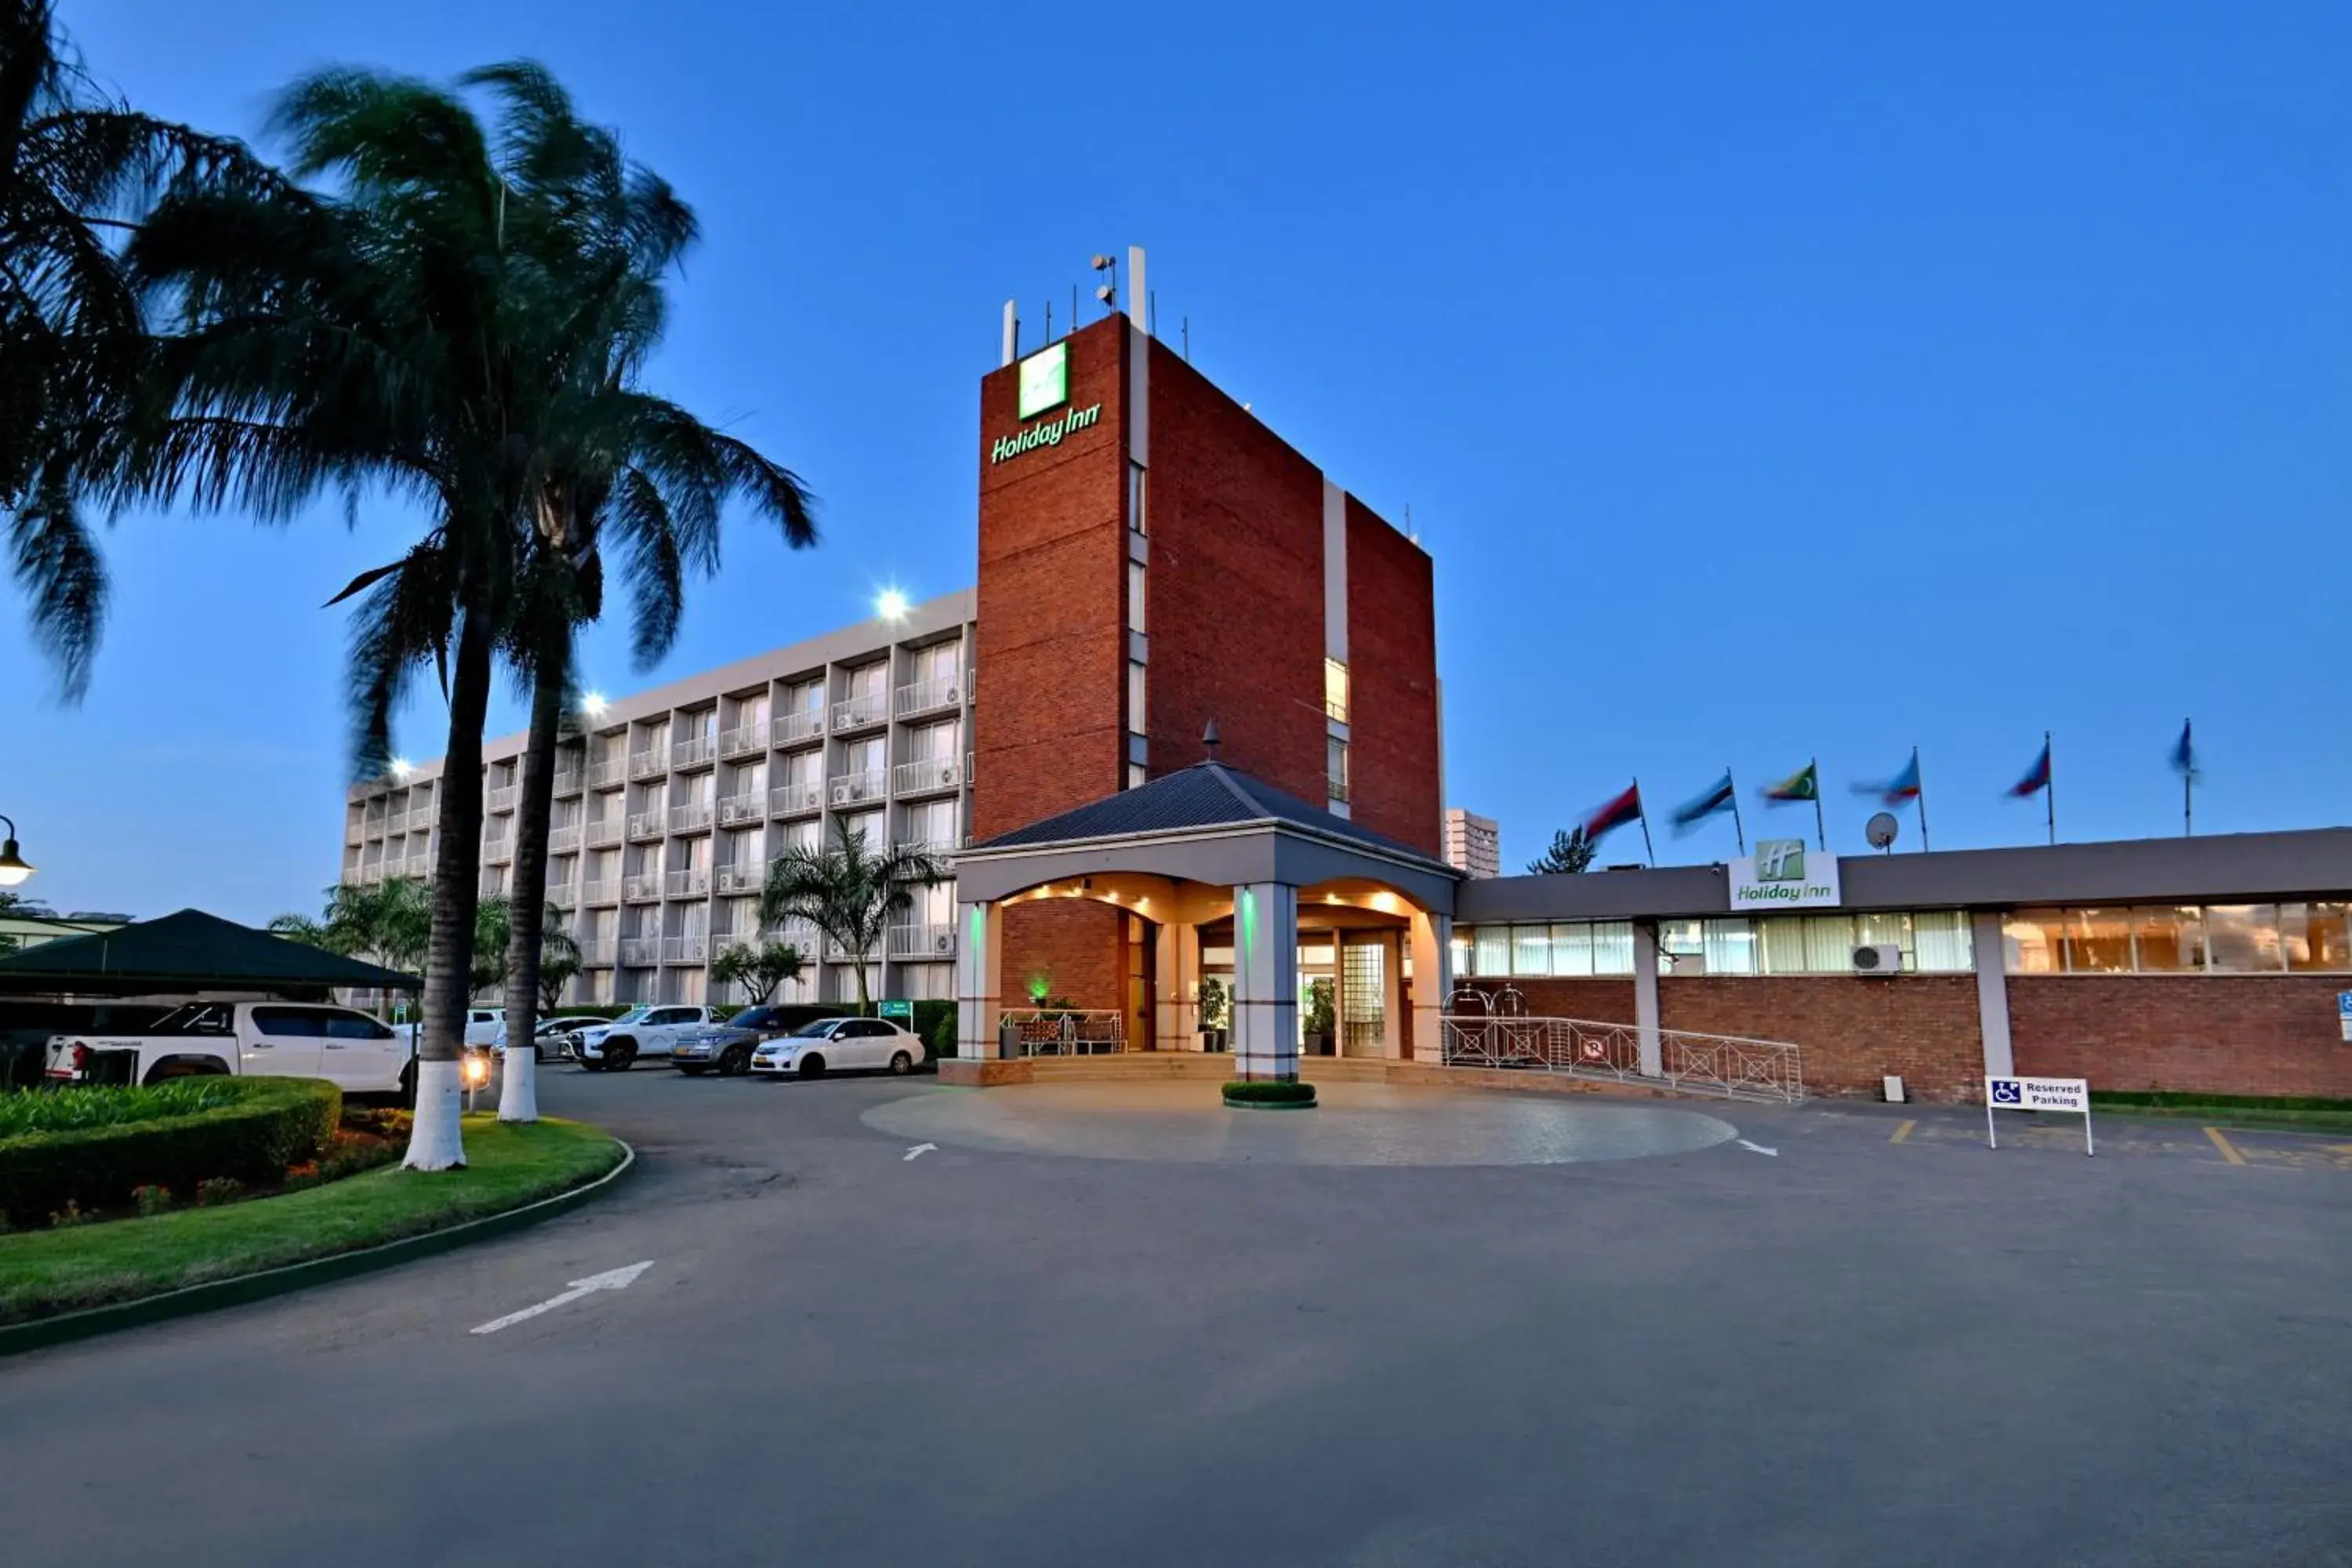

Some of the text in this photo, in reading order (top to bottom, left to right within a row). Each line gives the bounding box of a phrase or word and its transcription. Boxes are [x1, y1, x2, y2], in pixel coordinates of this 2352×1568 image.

[992, 403, 1101, 463] Holiday Inn
[1738, 884, 1801, 901] Holiday
[2027, 1083, 2082, 1094] Reserved
[2032, 1095, 2078, 1107] Parking
